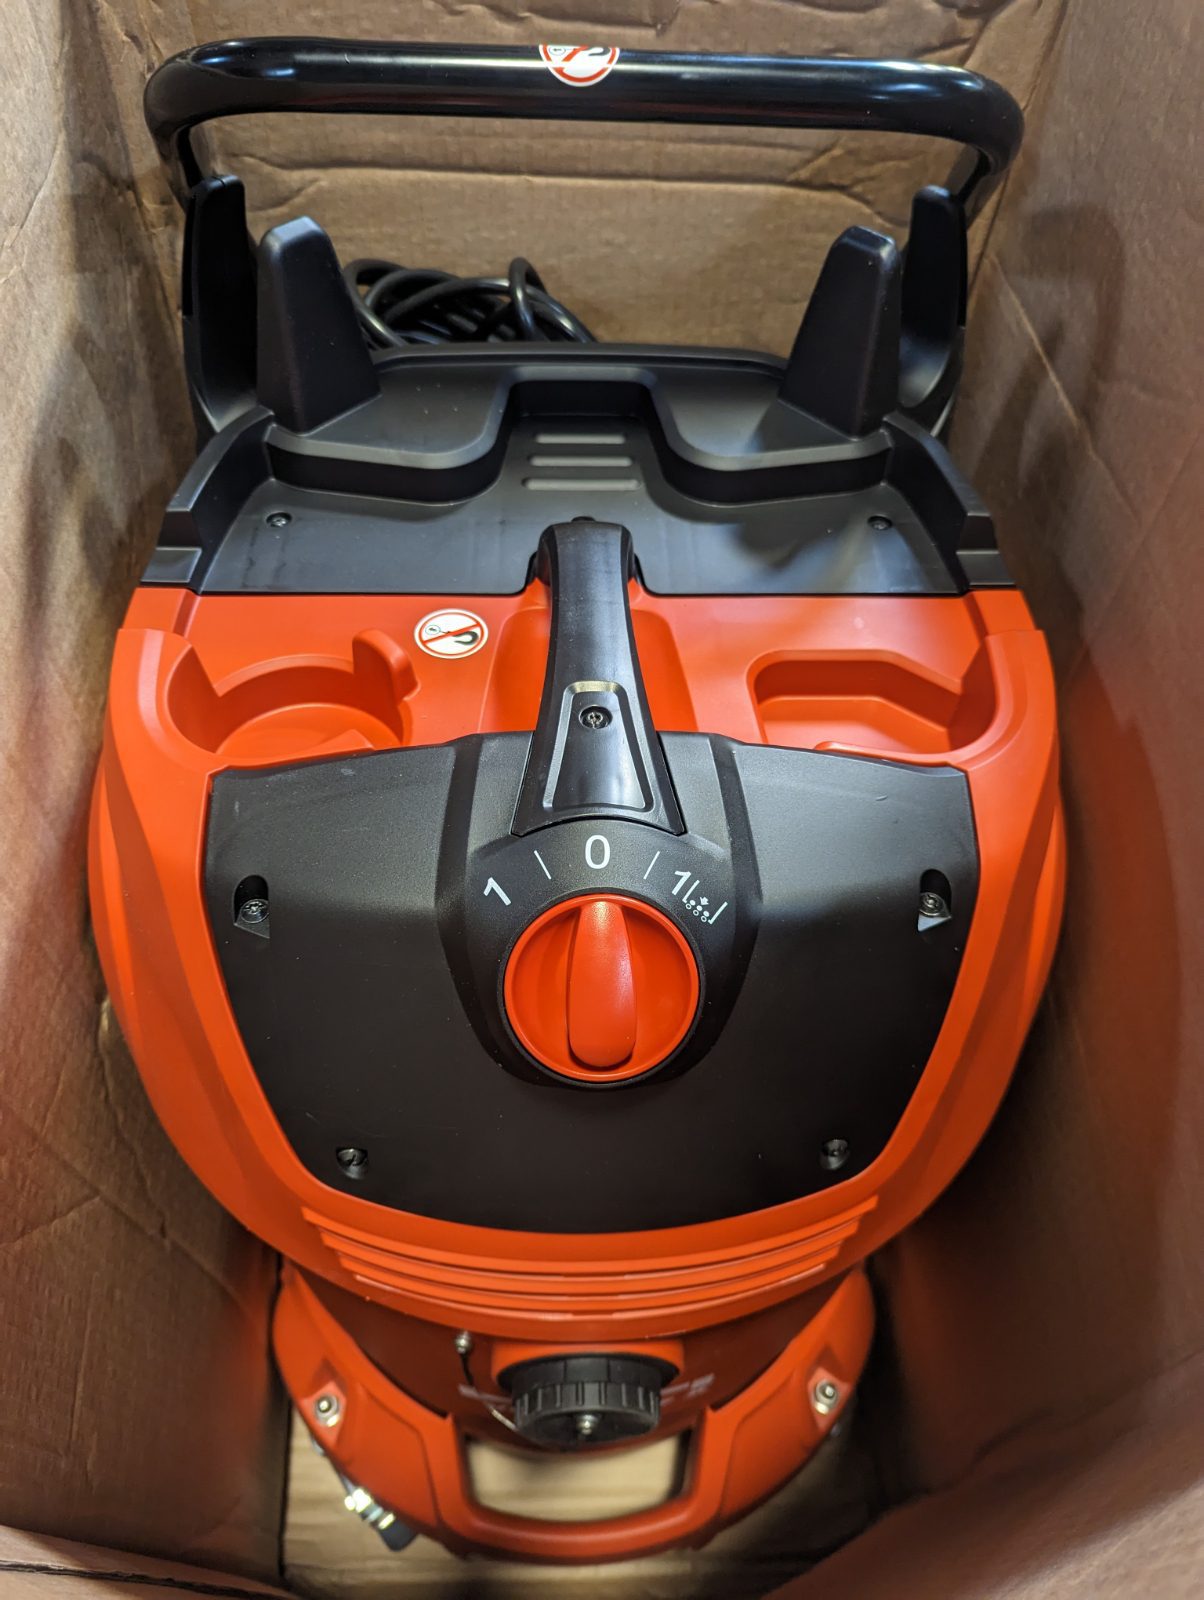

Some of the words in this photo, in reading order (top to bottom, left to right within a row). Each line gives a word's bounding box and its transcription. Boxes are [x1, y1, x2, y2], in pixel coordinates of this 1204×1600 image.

[584, 834, 611, 870] 0
[483, 877, 512, 906] 1
[671, 870, 692, 895] 1
